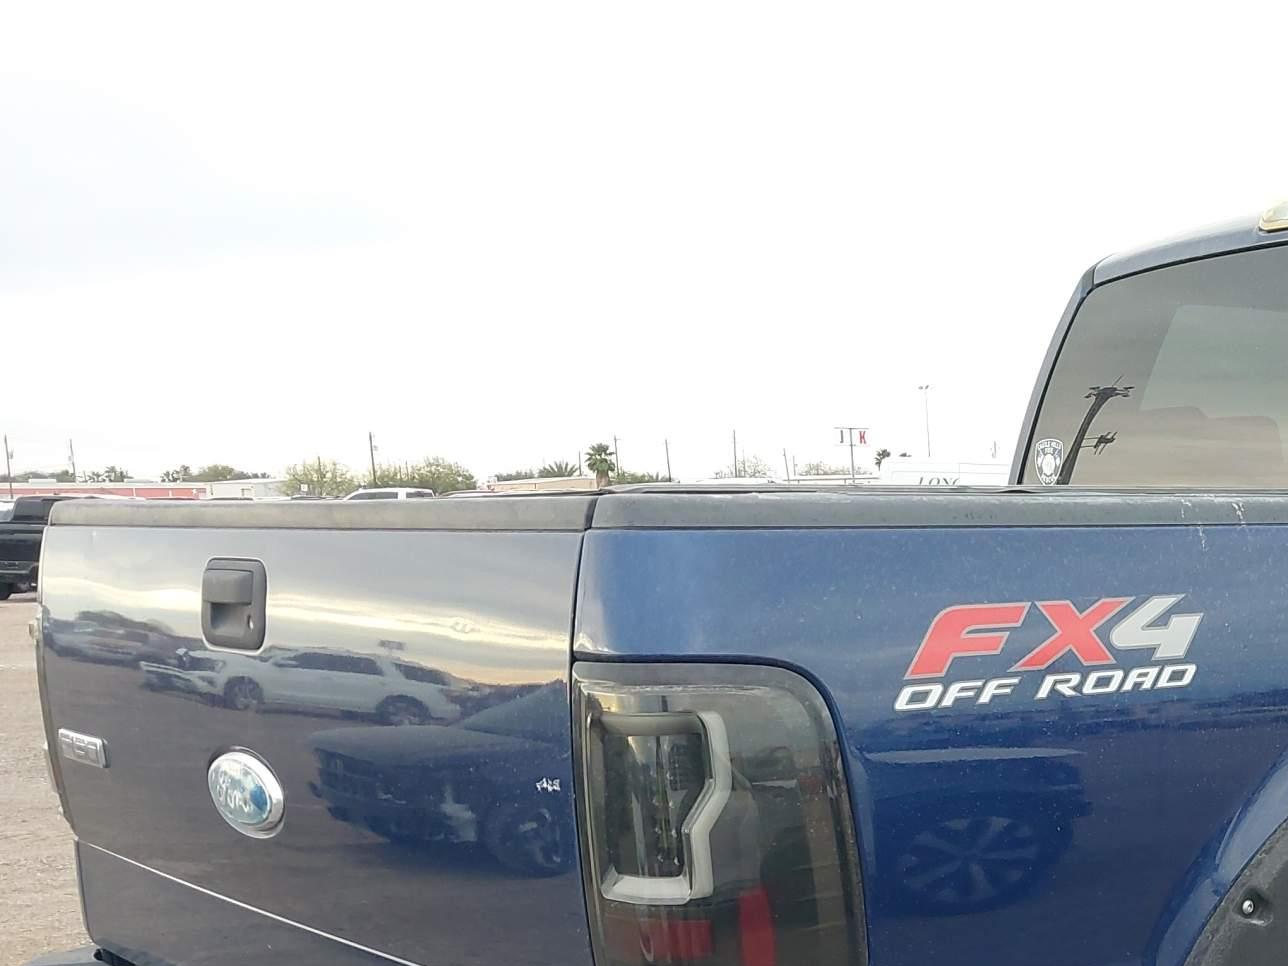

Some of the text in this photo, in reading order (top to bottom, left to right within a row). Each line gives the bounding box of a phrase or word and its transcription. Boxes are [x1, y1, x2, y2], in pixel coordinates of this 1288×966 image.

[858, 430, 867, 445] K
[903, 594, 1204, 680] FX4
[893, 656, 1198, 712] OFF ROAD
